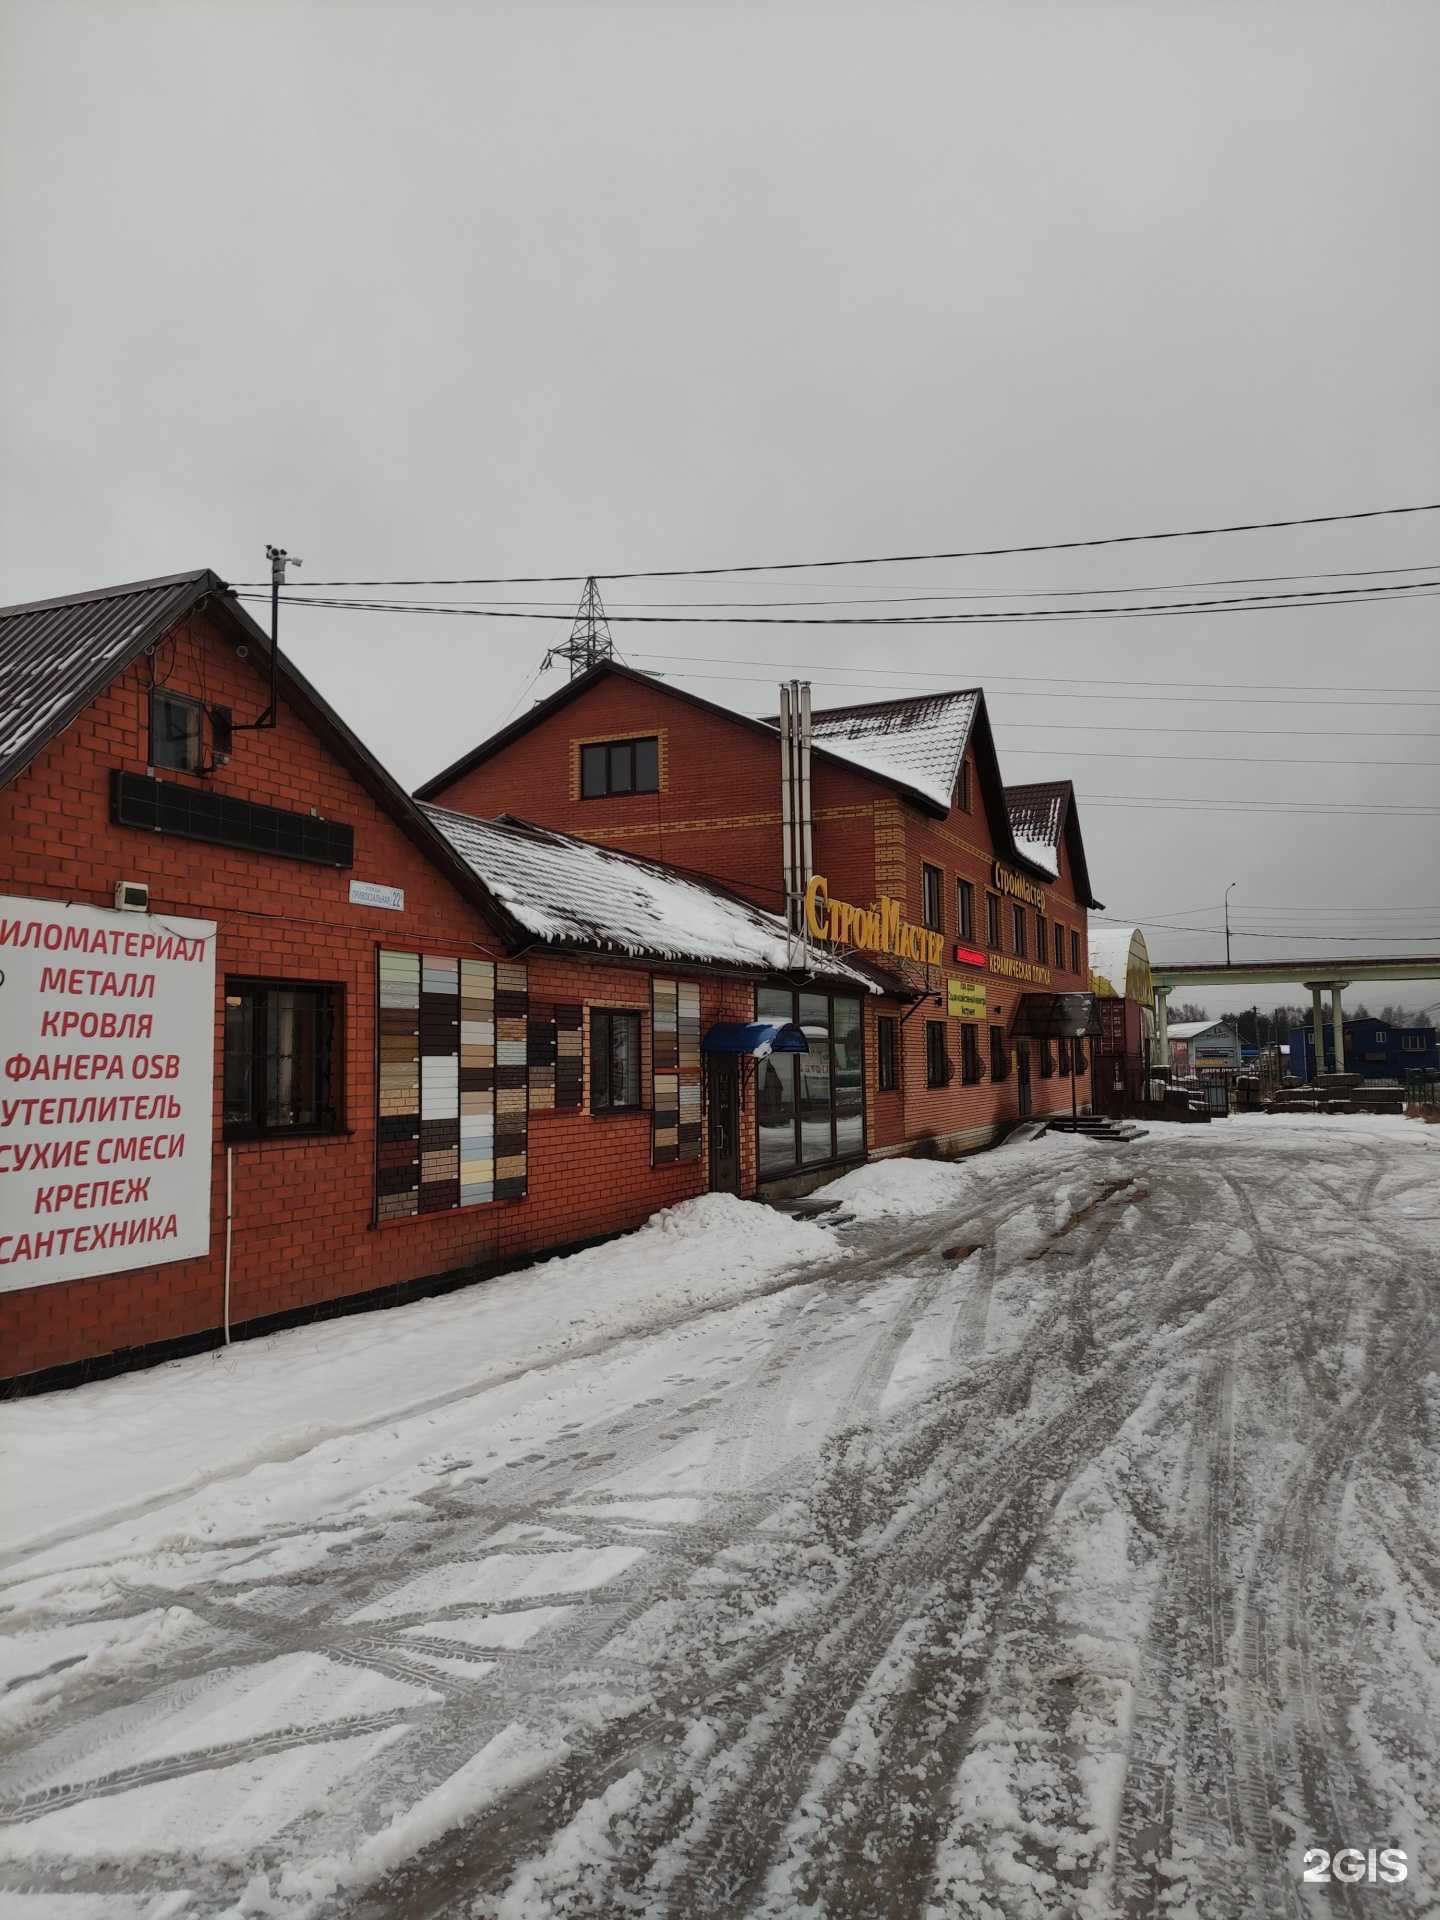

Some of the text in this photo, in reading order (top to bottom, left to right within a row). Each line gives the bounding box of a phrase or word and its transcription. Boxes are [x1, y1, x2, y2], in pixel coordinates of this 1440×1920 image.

[392, 891, 401, 907] 22
[39, 966, 155, 998] МЕТАЛЛ
[40, 1011, 153, 1039] КРОВЛЯ
[5, 1053, 180, 1081] ФАНЕРА OSB
[1, 1094, 182, 1127] УТЕПЛИТЕЛЬ
[0, 1134, 186, 1173] СУХИЕ СМЕСИ
[35, 1177, 151, 1214] КРЕПЕЖ
[0, 1214, 178, 1264] САНТЕХНИКА
